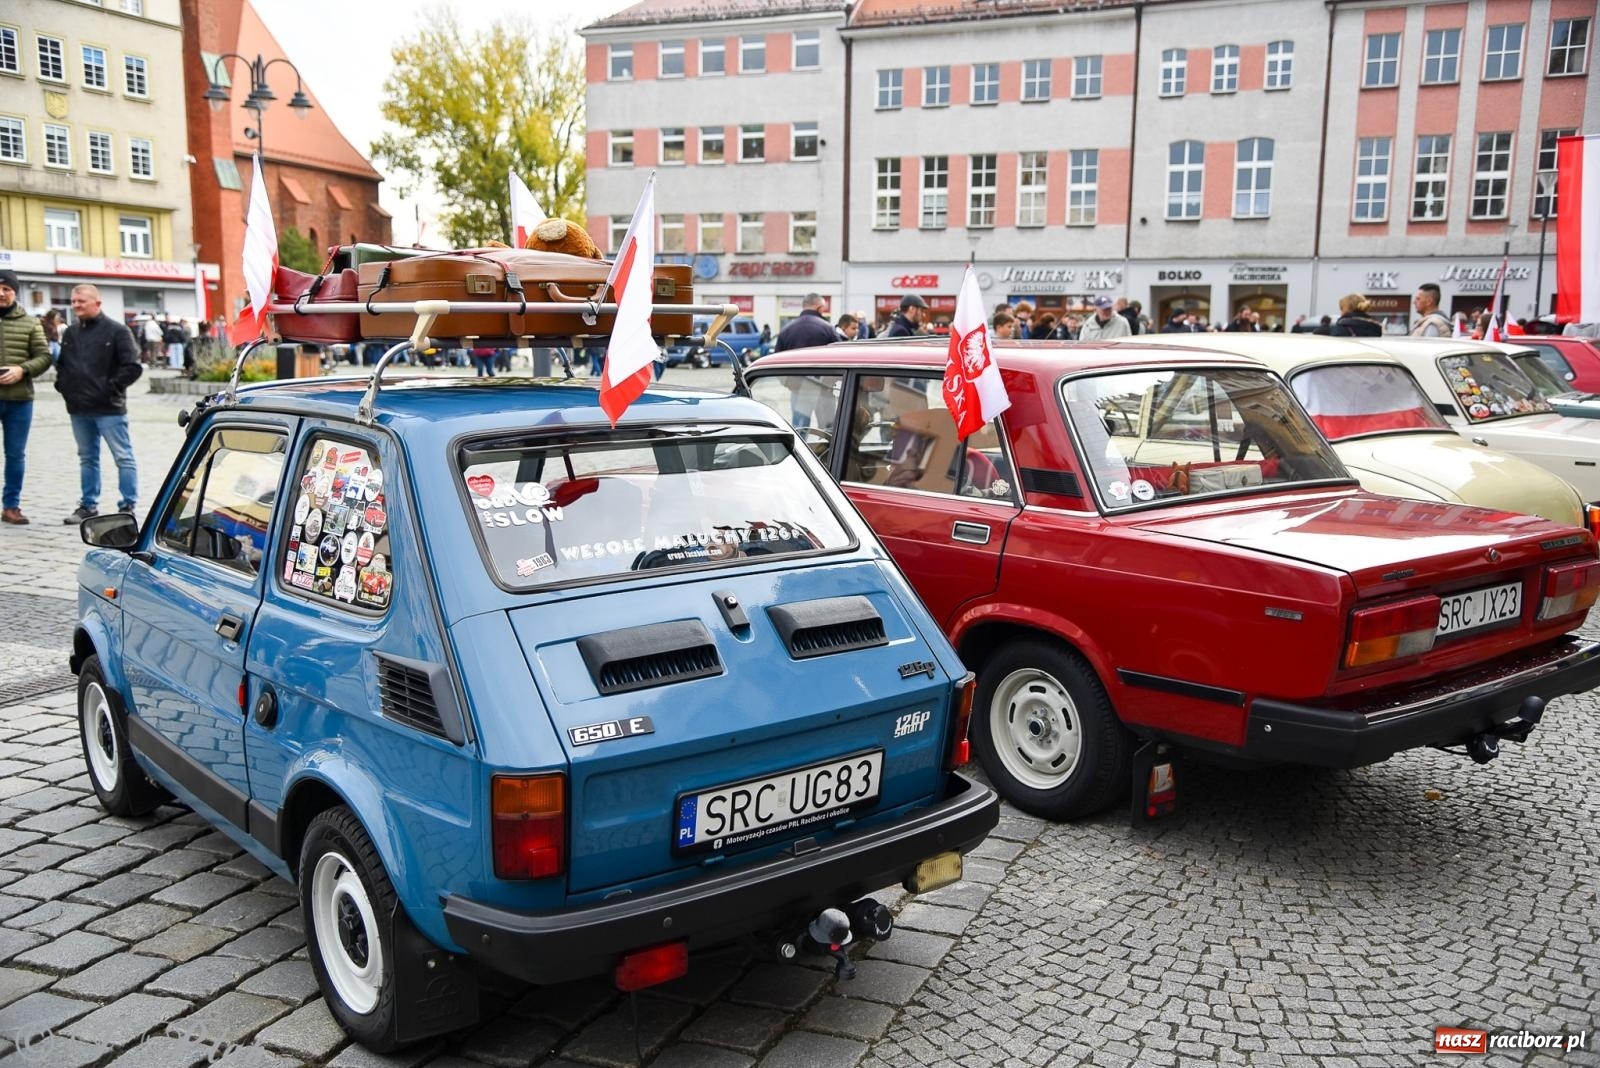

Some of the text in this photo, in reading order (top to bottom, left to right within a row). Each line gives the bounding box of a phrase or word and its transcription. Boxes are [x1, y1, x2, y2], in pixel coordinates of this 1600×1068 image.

[1000, 267, 1074, 282] JUBILER
[1158, 270, 1202, 281] BOLKO
[494, 506, 564, 528] SLOW
[532, 554, 552, 568] 1983
[1439, 586, 1517, 631] SRC JX23
[574, 717, 645, 743] 650 E
[679, 759, 873, 840] PL SRC UG83
[726, 830, 765, 845] Motoryzacja
[765, 824, 788, 835] czasów
[788, 820, 800, 830] PRL
[800, 813, 826, 826] Racibórz
[829, 807, 850, 818] okolice
